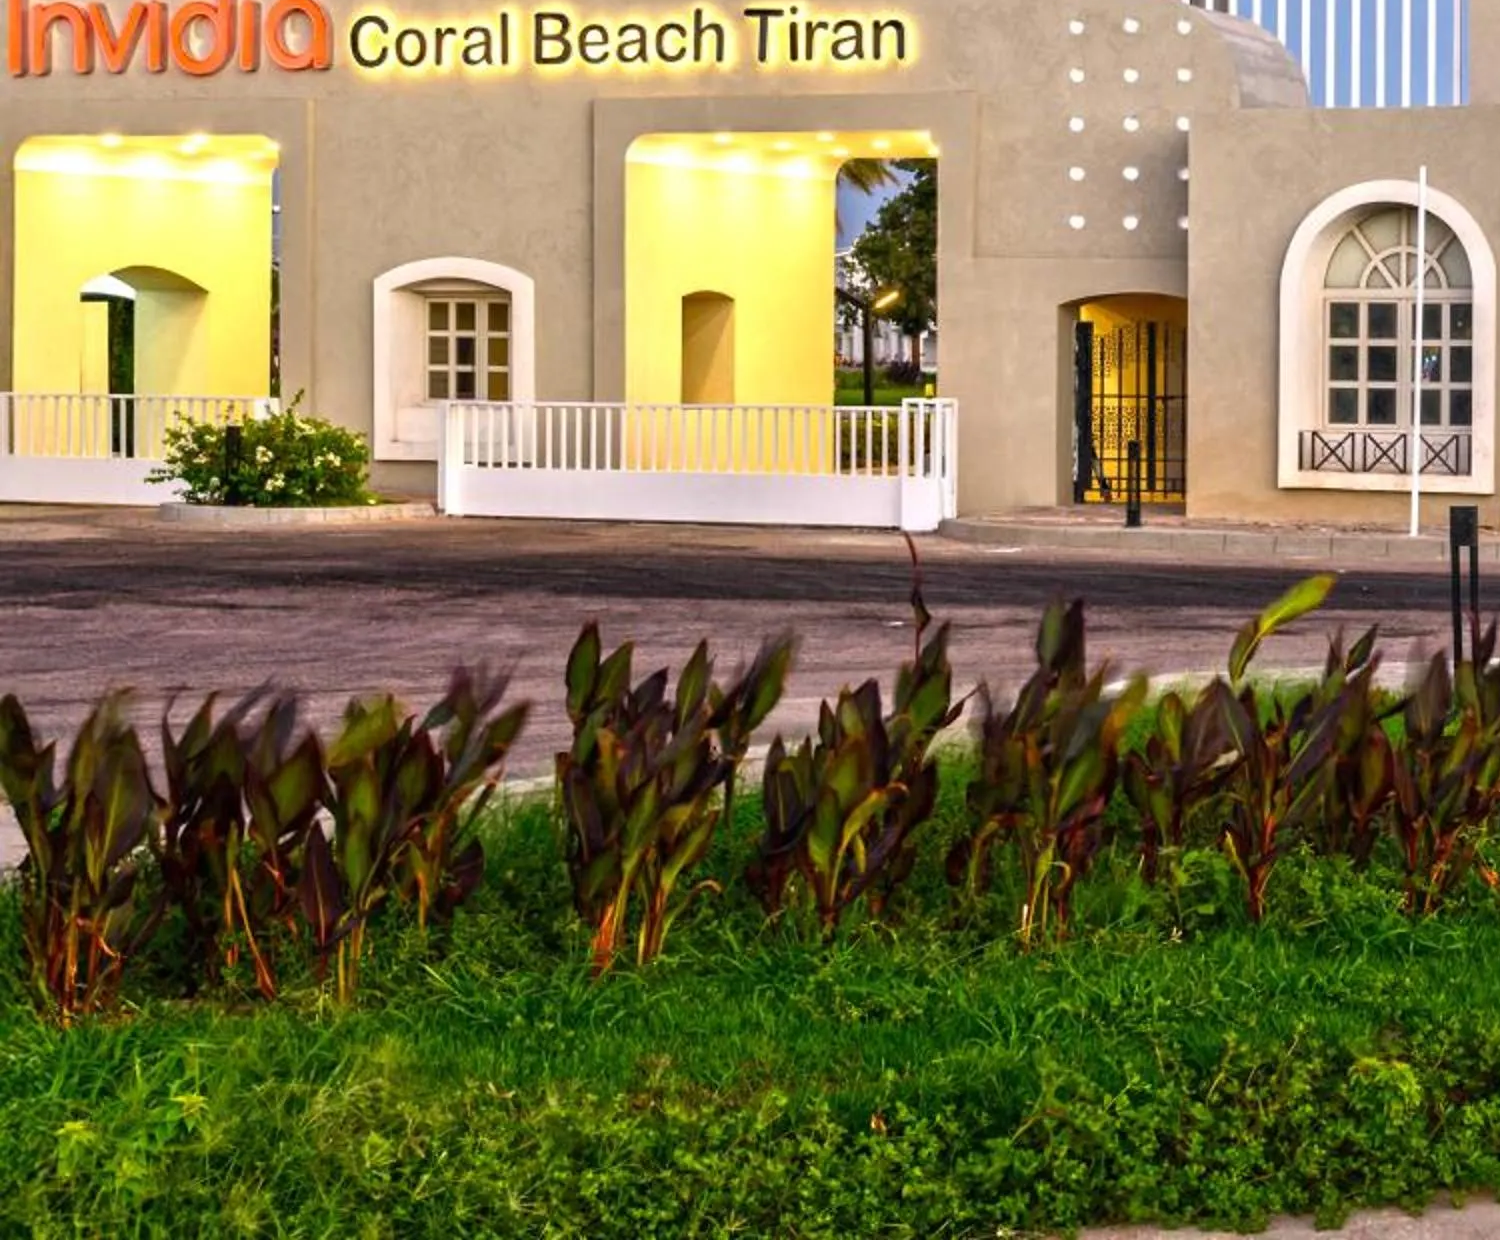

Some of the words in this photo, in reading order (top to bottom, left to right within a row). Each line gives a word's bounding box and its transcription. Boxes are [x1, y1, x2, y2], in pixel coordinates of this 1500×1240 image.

[350, 13, 509, 68] Coral
[534, 8, 725, 65] Beach
[744, 6, 905, 62] Tiran
